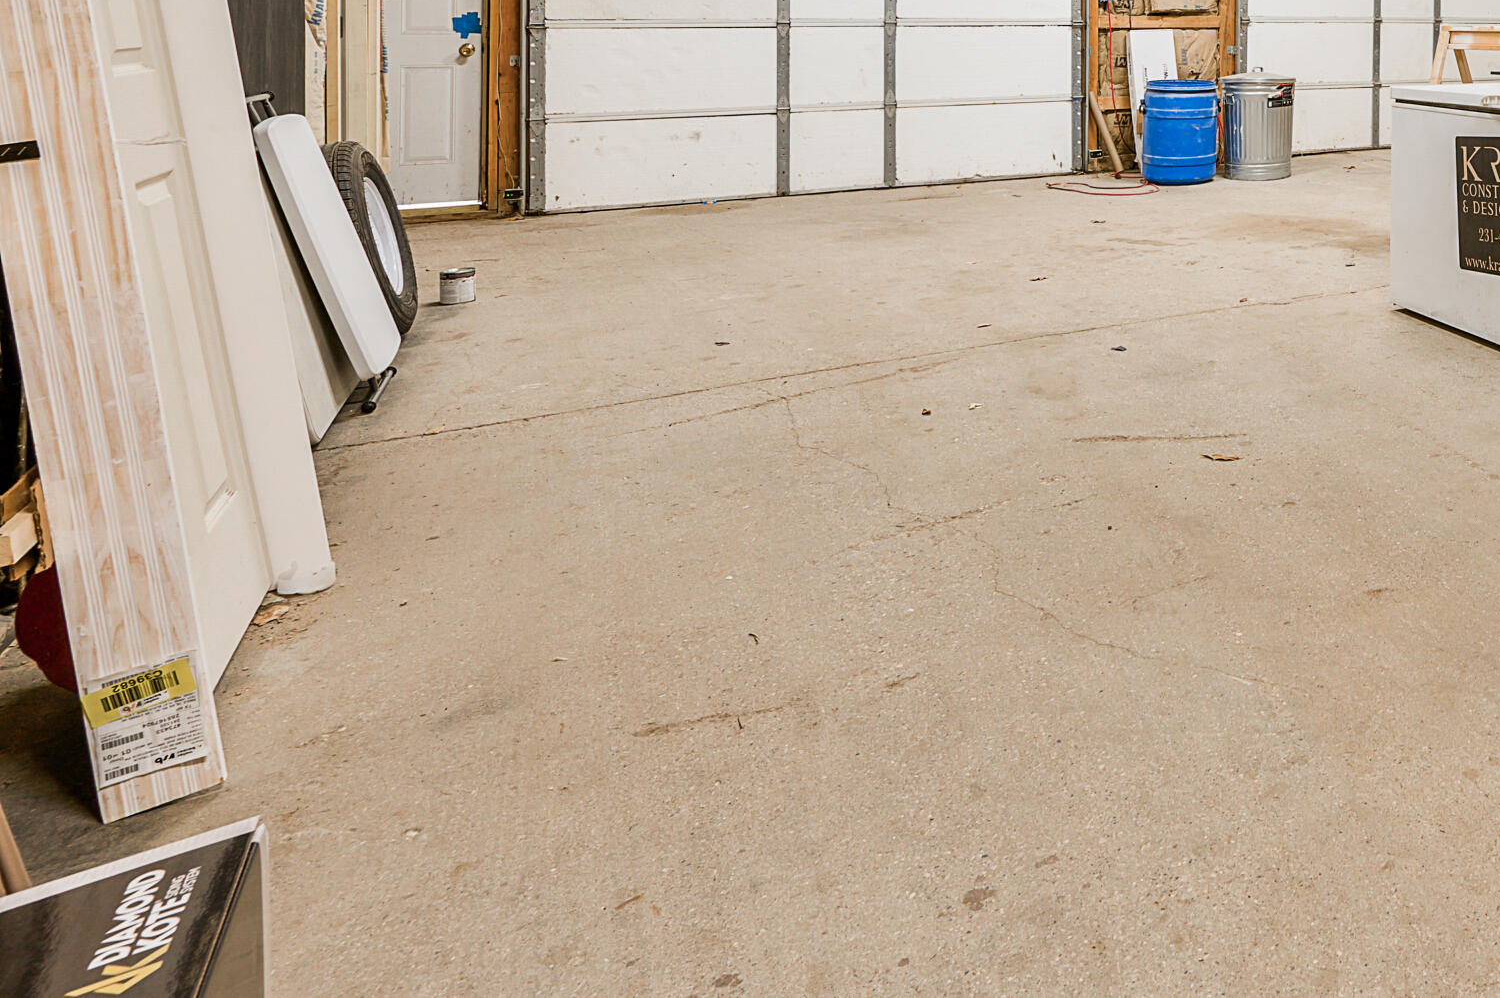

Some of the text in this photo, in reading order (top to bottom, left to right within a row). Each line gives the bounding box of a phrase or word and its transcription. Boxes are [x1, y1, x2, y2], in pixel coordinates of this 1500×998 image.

[1463, 200, 1469, 213] &
[111, 669, 164, 694] C39682
[180, 866, 202, 895] SYSTEM
[87, 869, 166, 970] DIAMOND
[132, 892, 192, 955] KOTE
